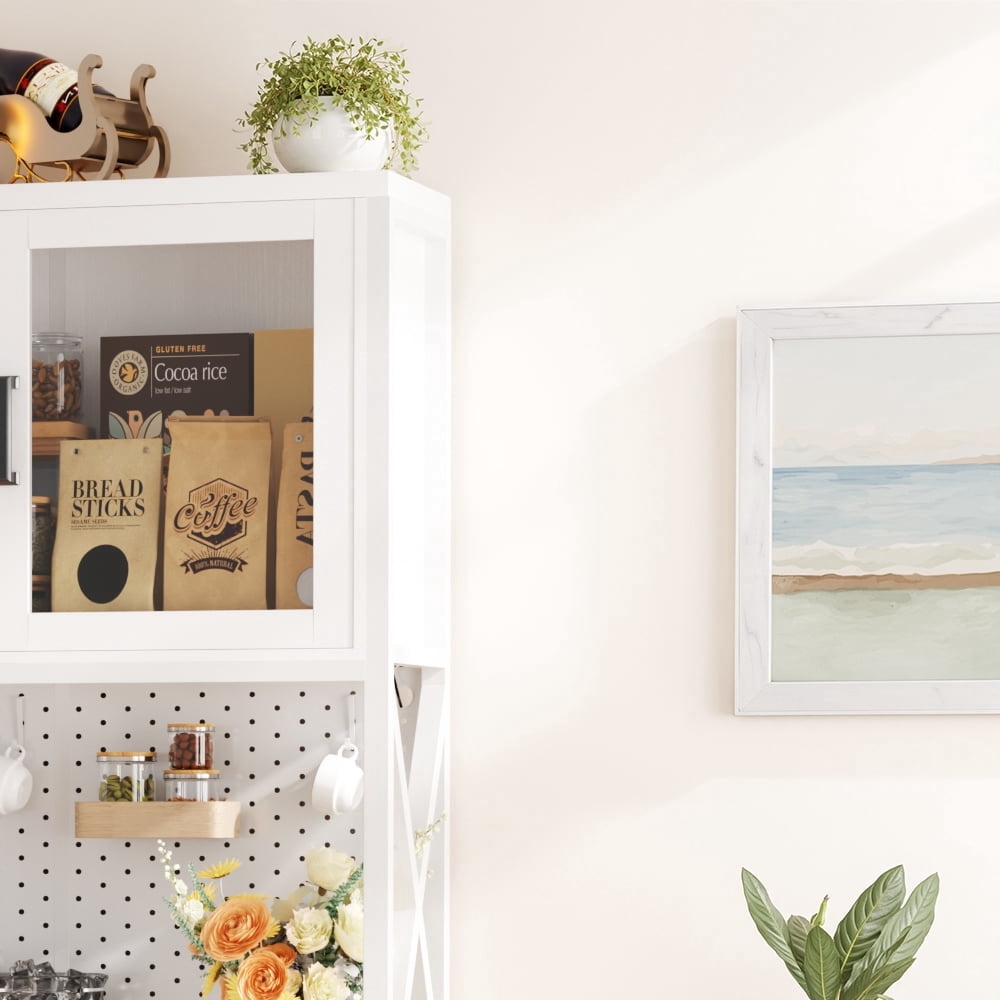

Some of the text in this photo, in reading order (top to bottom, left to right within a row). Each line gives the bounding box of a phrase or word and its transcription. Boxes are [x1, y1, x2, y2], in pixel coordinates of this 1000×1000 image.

[155, 344, 207, 354] GLUTEN FREE
[154, 361, 228, 382] Cocoa rice
[71, 478, 144, 499] BREAD
[71, 498, 145, 519] STICKS
[174, 492, 258, 531] Coffee
